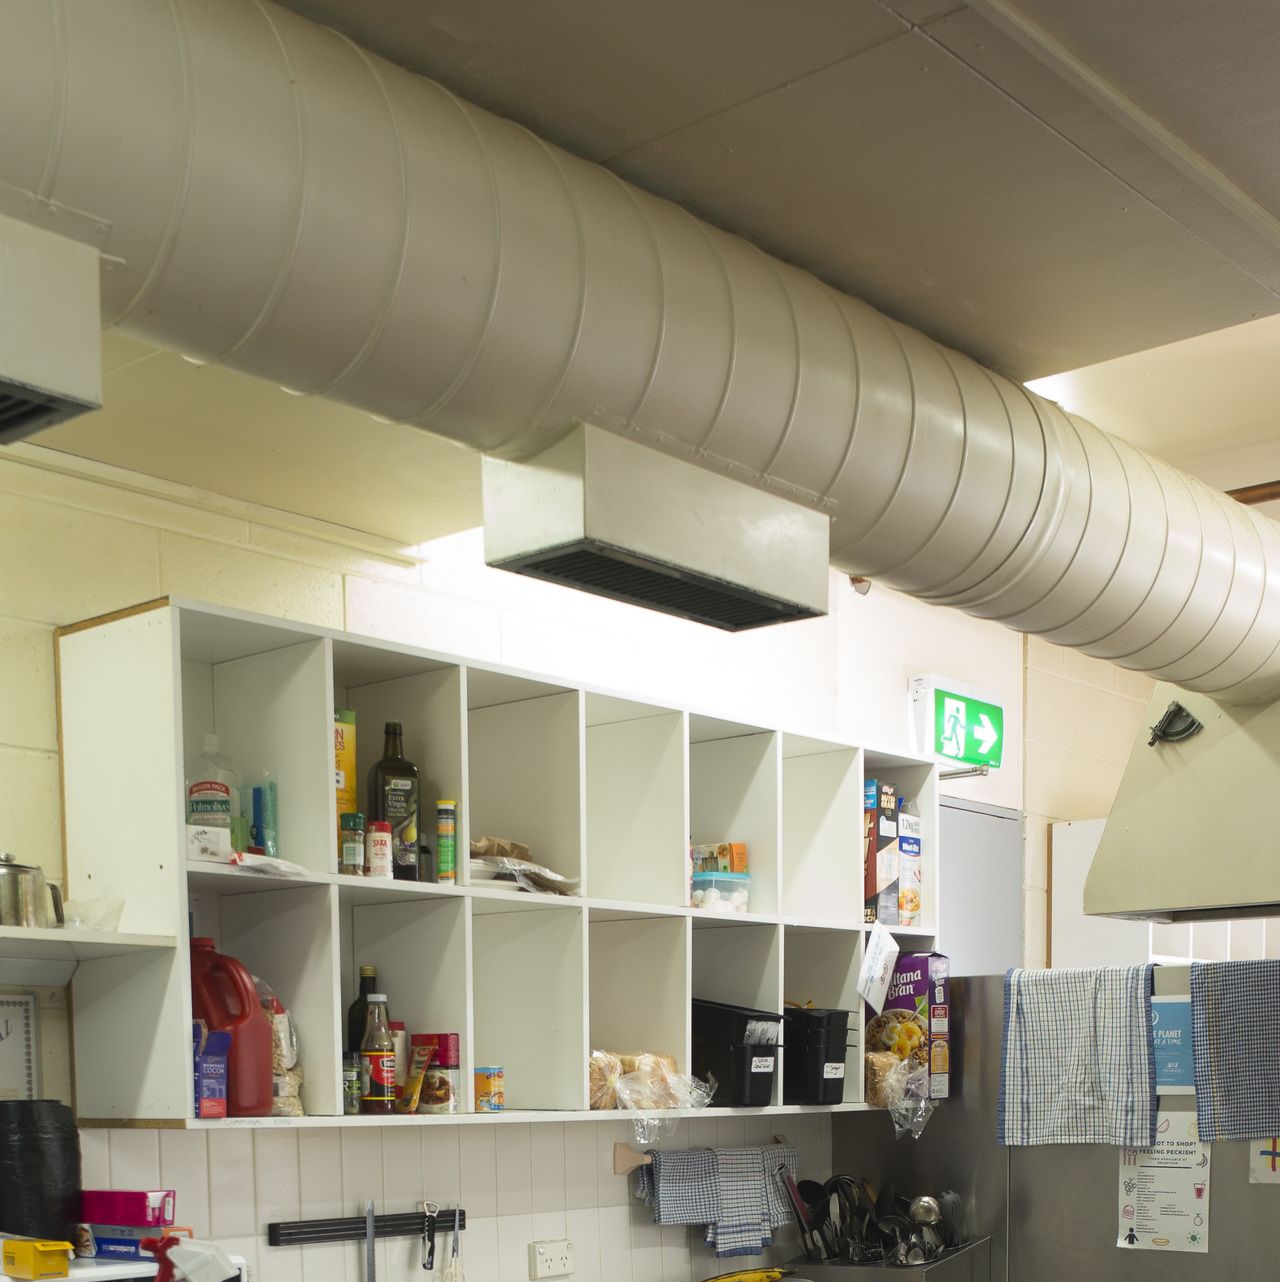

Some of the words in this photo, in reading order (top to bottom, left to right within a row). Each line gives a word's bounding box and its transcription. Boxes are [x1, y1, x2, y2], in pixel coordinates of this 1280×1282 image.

[388, 801, 407, 809] Virgin
[372, 839, 388, 848] SAXA
[888, 969, 922, 987] ltana
[888, 984, 915, 1000] Bran
[1158, 1030, 1182, 1038] PLANET
